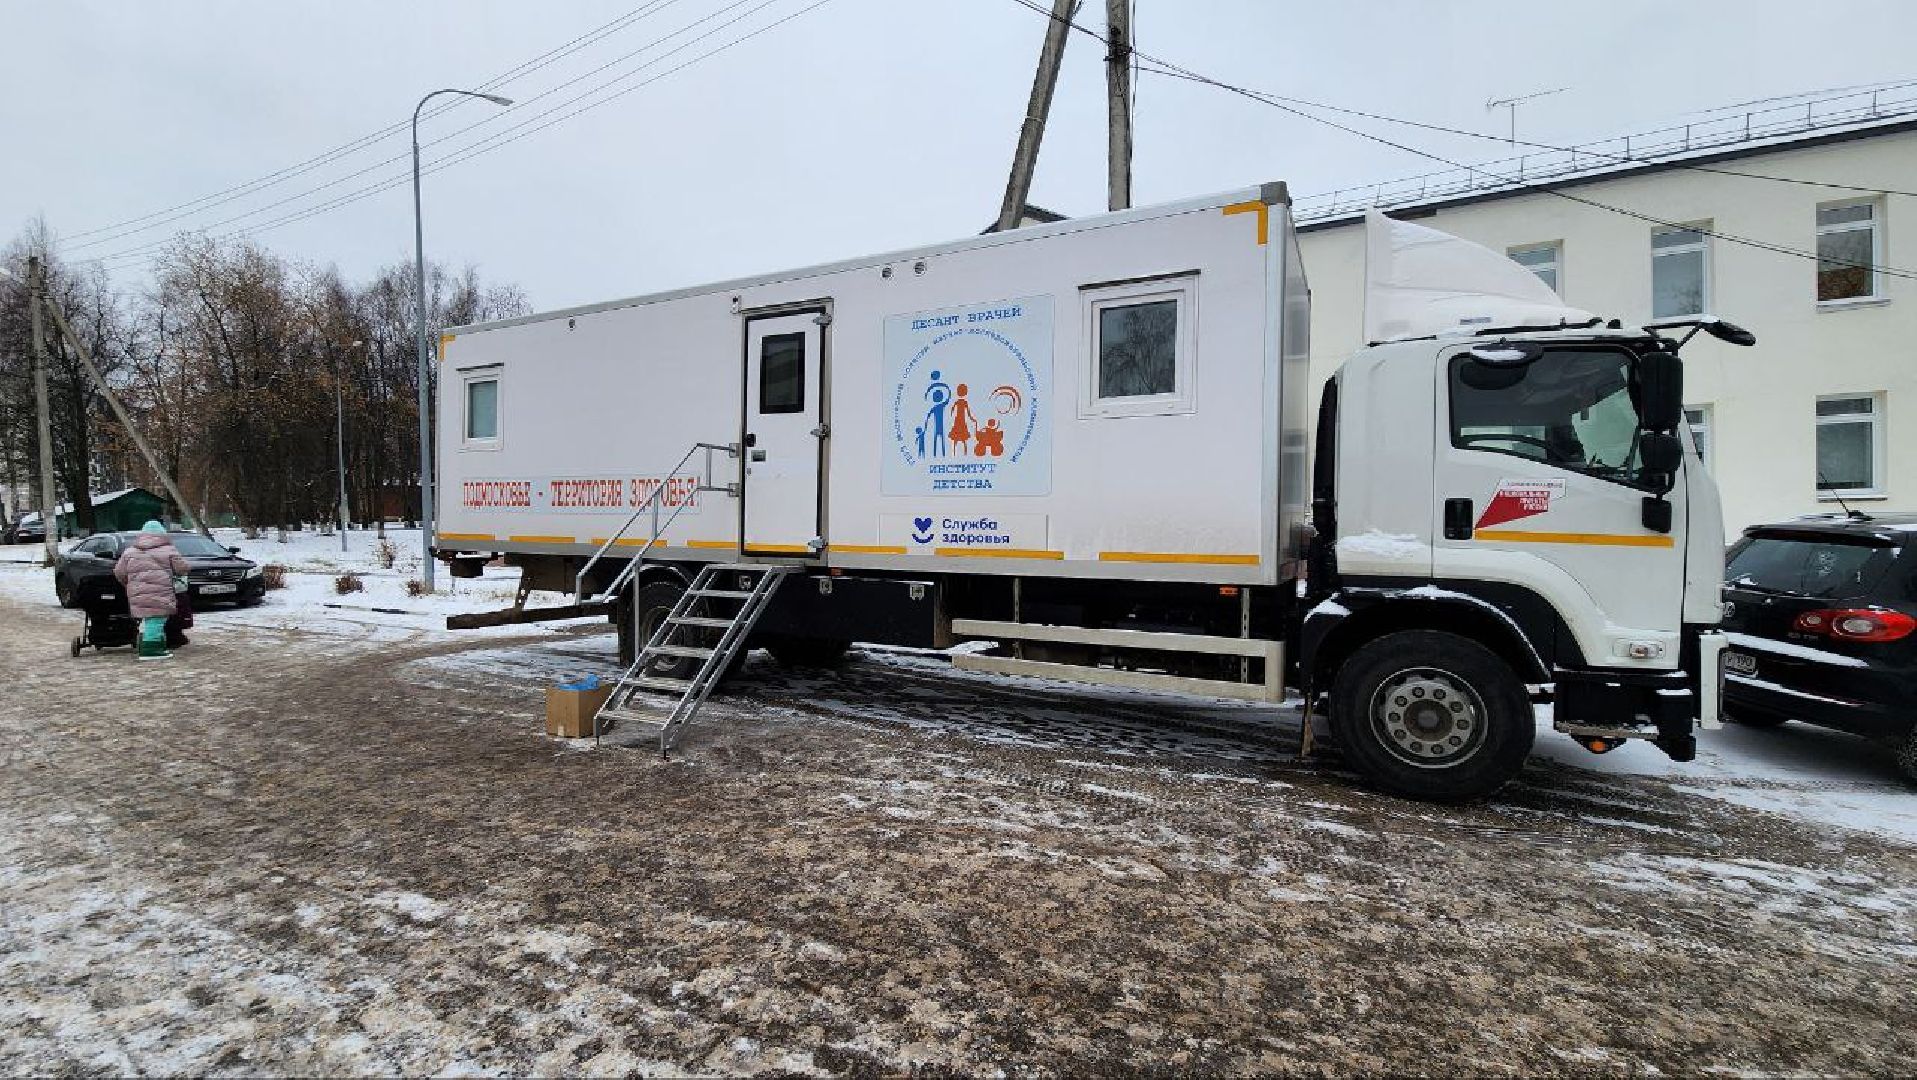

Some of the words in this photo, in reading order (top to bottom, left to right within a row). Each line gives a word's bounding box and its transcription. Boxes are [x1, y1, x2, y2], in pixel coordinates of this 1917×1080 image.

[911, 315, 960, 330] ДЕСАНТ
[929, 463, 997, 474] ИНСТИТУТ
[933, 479, 992, 489] ДЕТСТВА
[463, 481, 531, 508] ПОДМОСКОВЬЕ
[551, 479, 624, 507] ТЕРРИТОРИЯ
[942, 517, 998, 531] Служба
[942, 533, 1010, 545] здоровья
